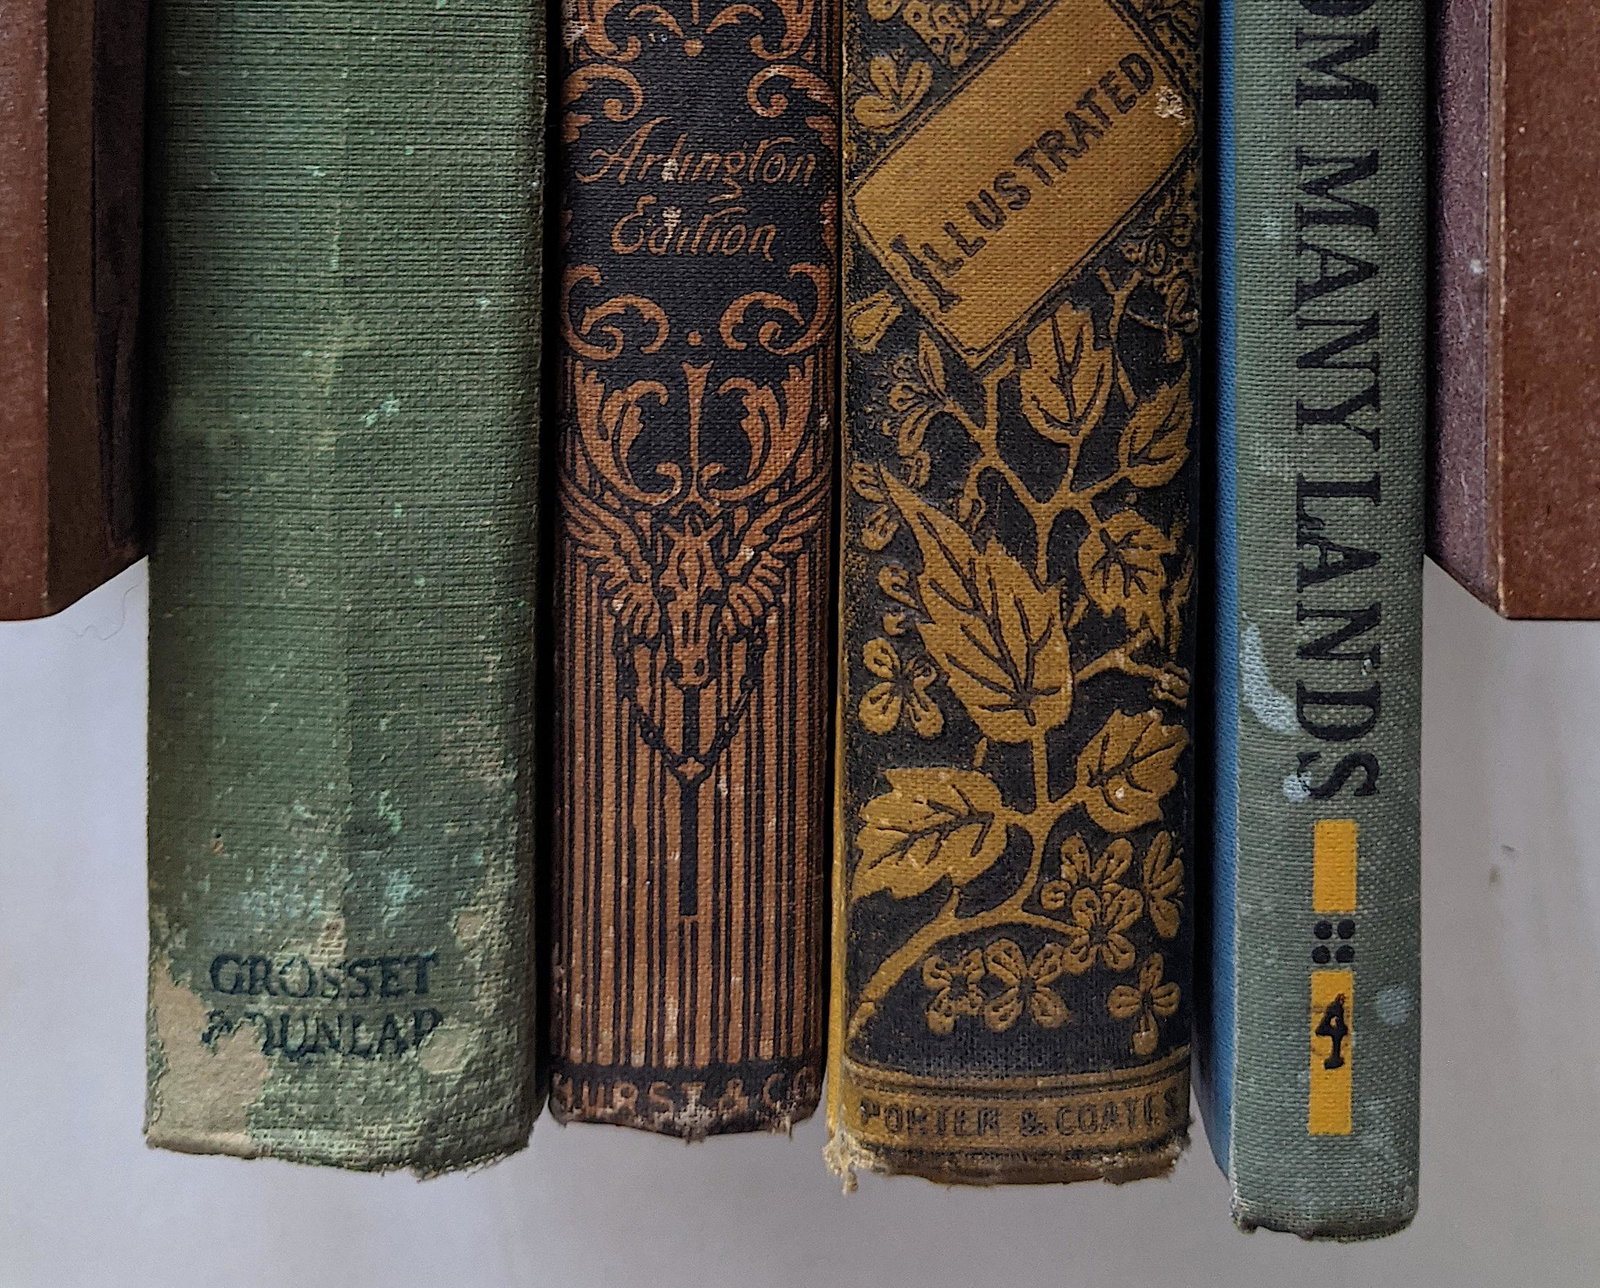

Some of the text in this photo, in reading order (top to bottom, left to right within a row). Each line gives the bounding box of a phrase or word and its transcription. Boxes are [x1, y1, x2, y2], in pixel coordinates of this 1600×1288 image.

[574, 116, 818, 204] Arlington
[888, 52, 1155, 312] ILLUSTRATED
[610, 195, 778, 263] Edition
[1296, 148, 1381, 454] MANY
[1296, 473, 1382, 800] LANDS
[208, 952, 440, 1000] GROSSET
[1315, 991, 1350, 1070] 4
[717, 1078, 749, 1113] &
[859, 1097, 1001, 1138] PORTER
[1020, 1105, 1049, 1137] &
